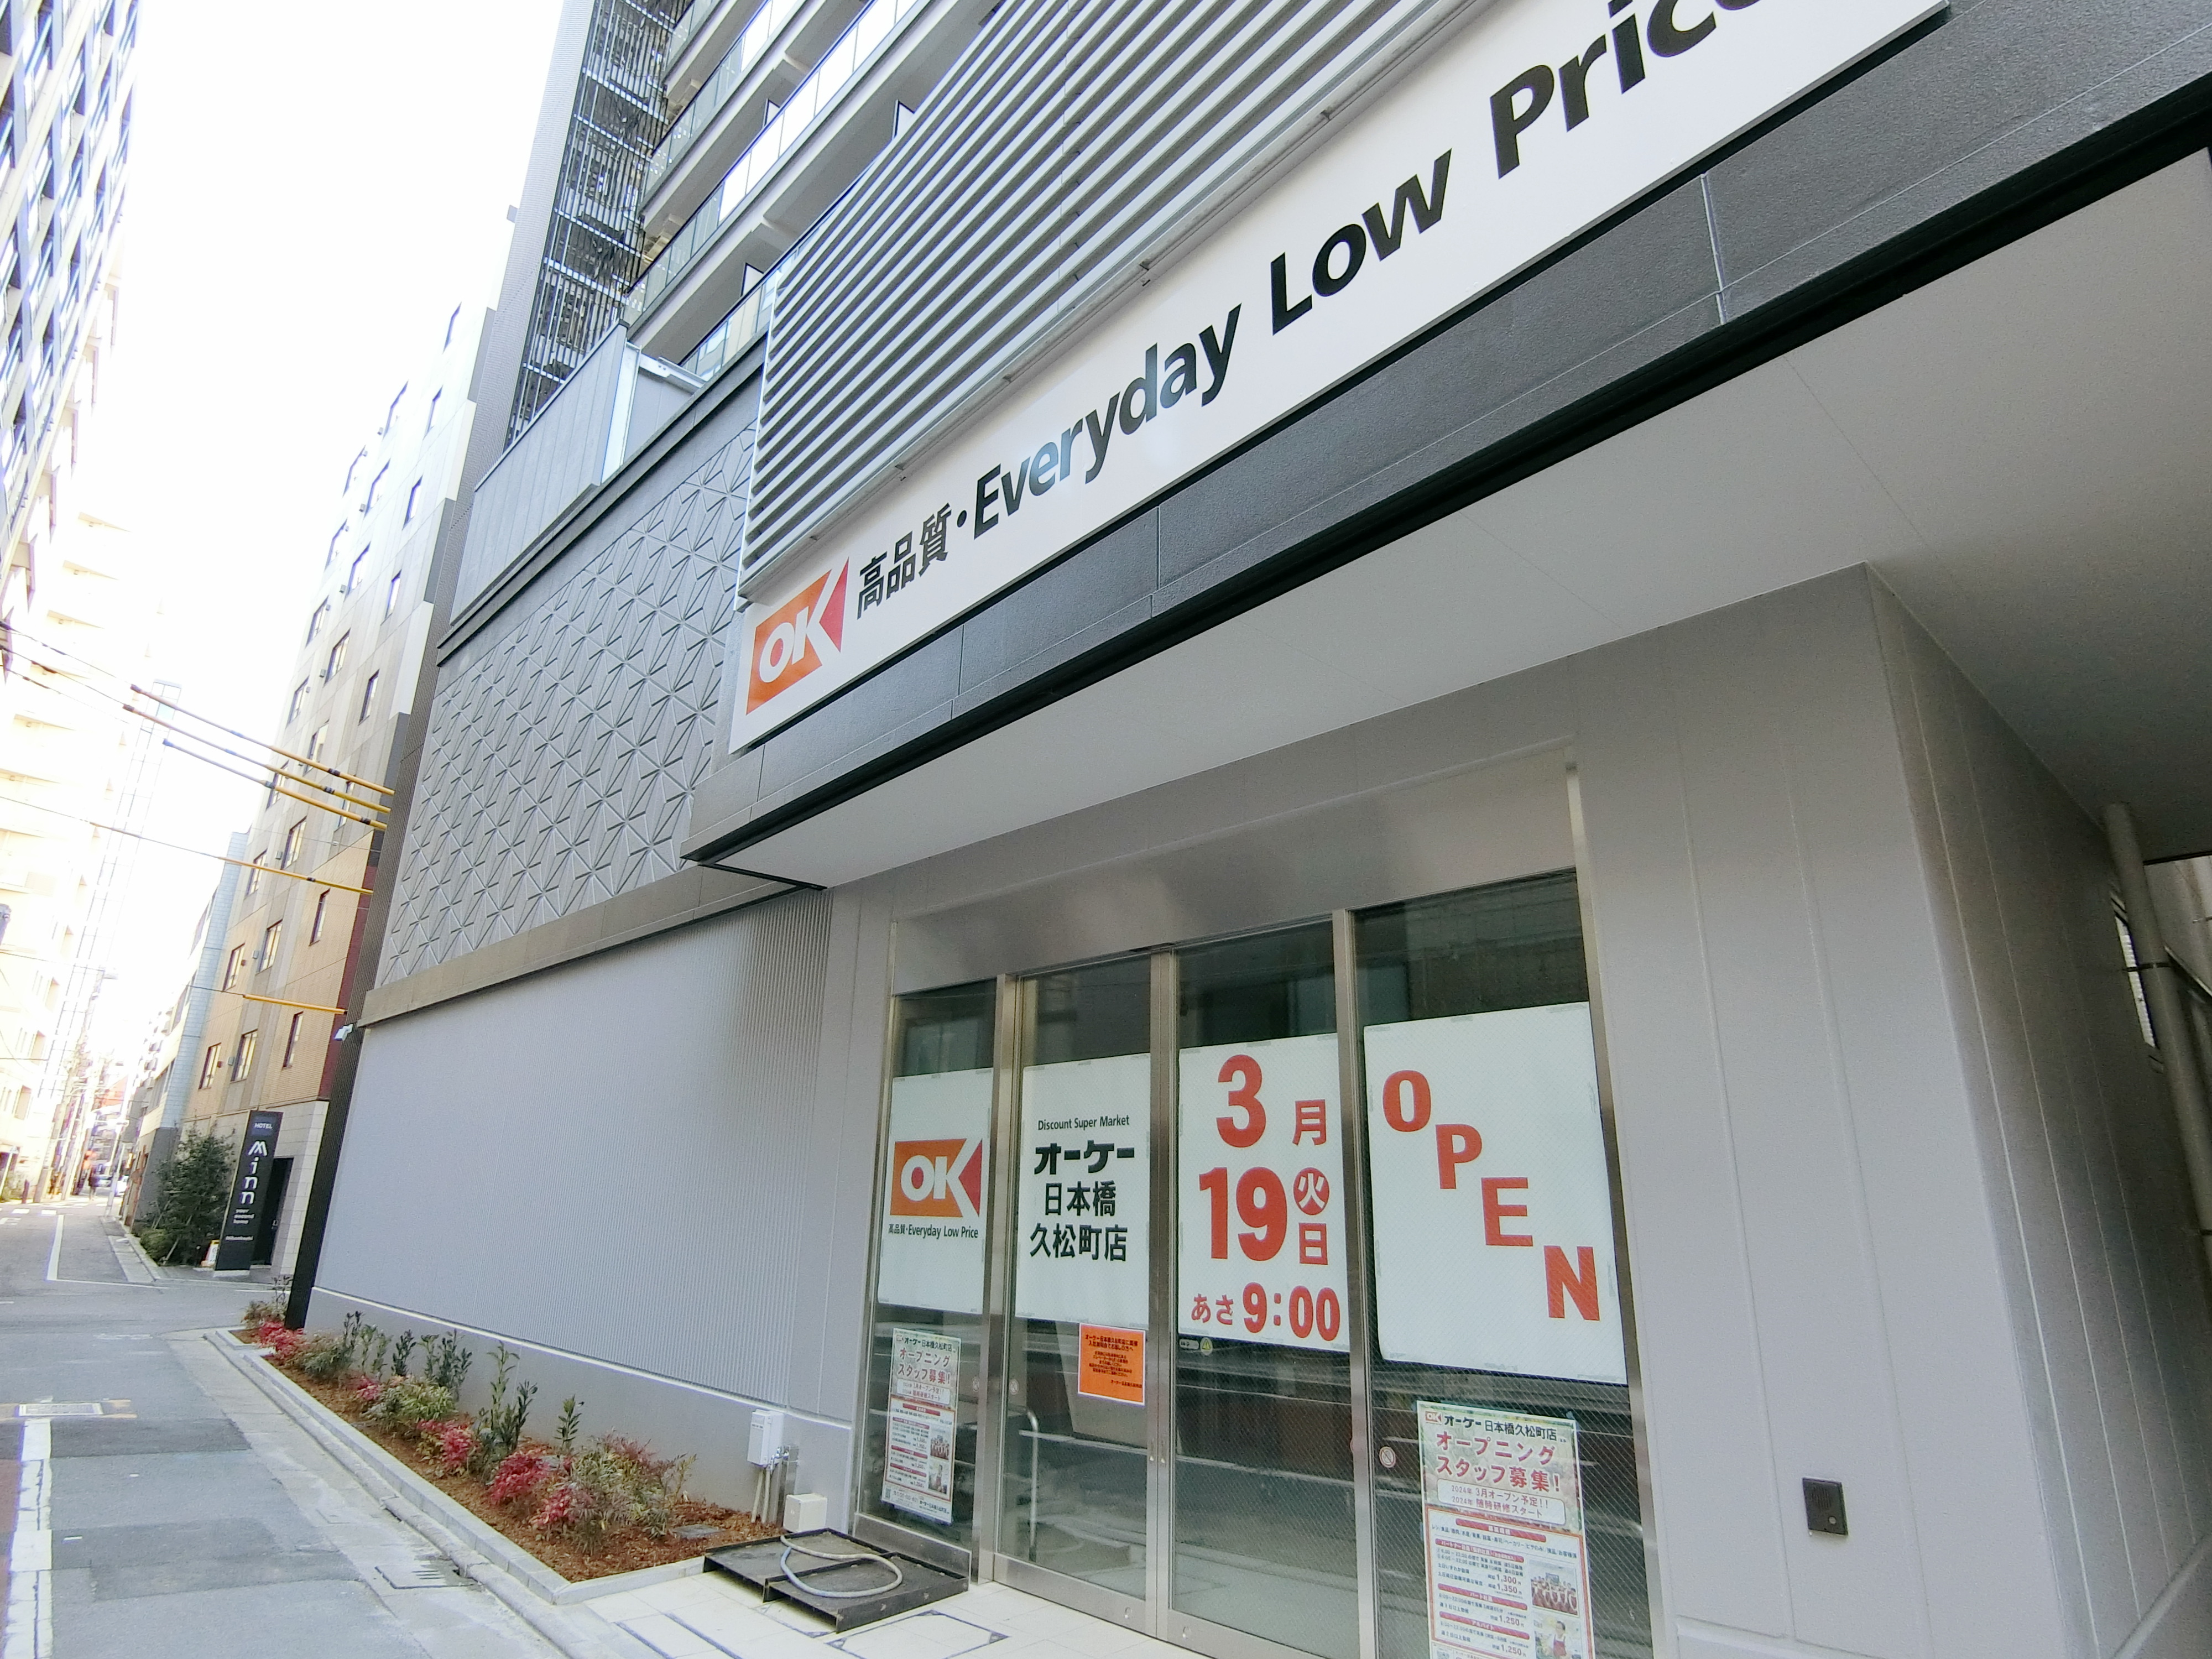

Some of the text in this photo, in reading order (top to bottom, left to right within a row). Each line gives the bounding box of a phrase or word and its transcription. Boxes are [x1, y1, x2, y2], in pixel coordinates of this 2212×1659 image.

[759, 557, 848, 684] OK
[1270, 148, 1452, 335] Low
[1490, 0, 1761, 180] Pric
[1038, 1114, 1129, 1130] Discount Super Market
[1034, 1140, 1135, 1175] オーケー
[900, 1139, 981, 1217] OK
[1045, 1180, 1117, 1217] 日本橋
[943, 1225, 959, 1237] Low
[961, 1225, 979, 1238] Price
[1030, 1223, 1128, 1261] 久松町店
[1437, 1431, 1556, 1465] オープニング
